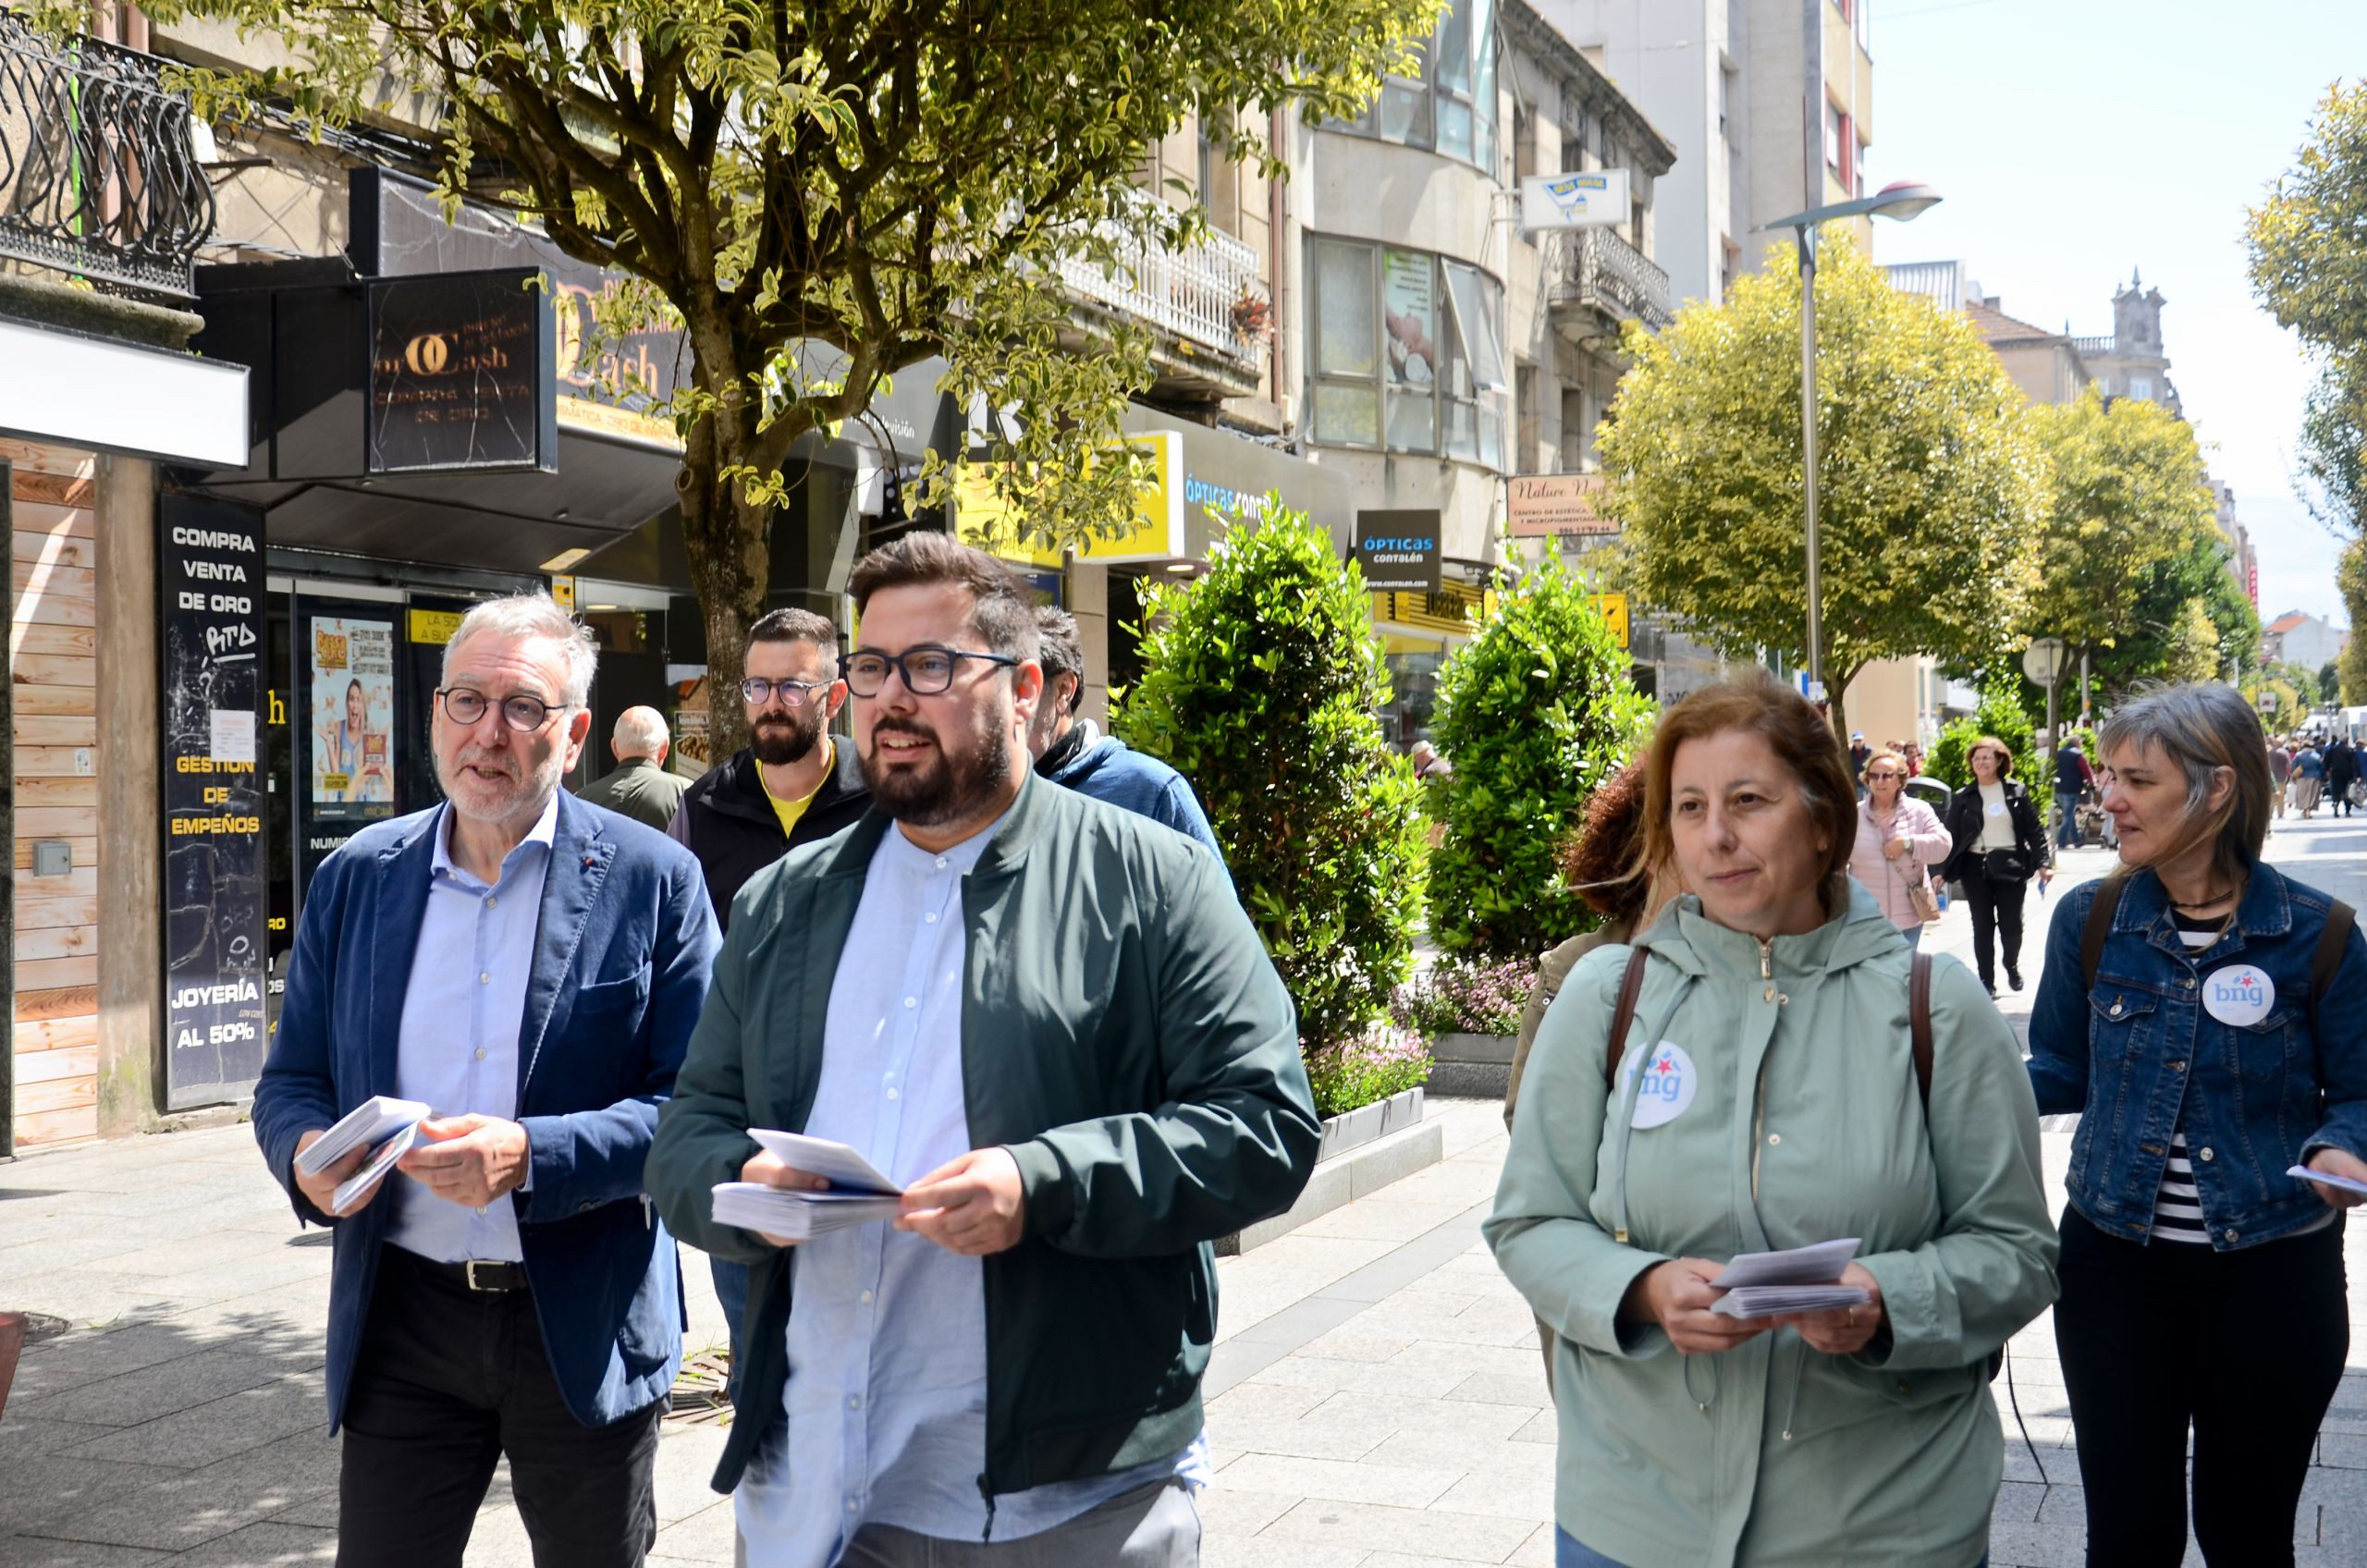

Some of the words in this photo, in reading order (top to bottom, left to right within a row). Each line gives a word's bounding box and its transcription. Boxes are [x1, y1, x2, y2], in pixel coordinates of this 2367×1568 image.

[173, 526, 255, 553] COMPRA
[183, 559, 247, 582] VENTA
[178, 591, 205, 611] DE
[211, 594, 251, 615] ORO
[203, 787, 228, 804] DE
[171, 813, 260, 835] EMPEÑOS
[171, 979, 259, 1010] JOYERÍA
[2214, 983, 2263, 1007] bng
[177, 1027, 204, 1048] AL
[209, 1022, 255, 1045] 50%
[1628, 1069, 1682, 1102] ng
